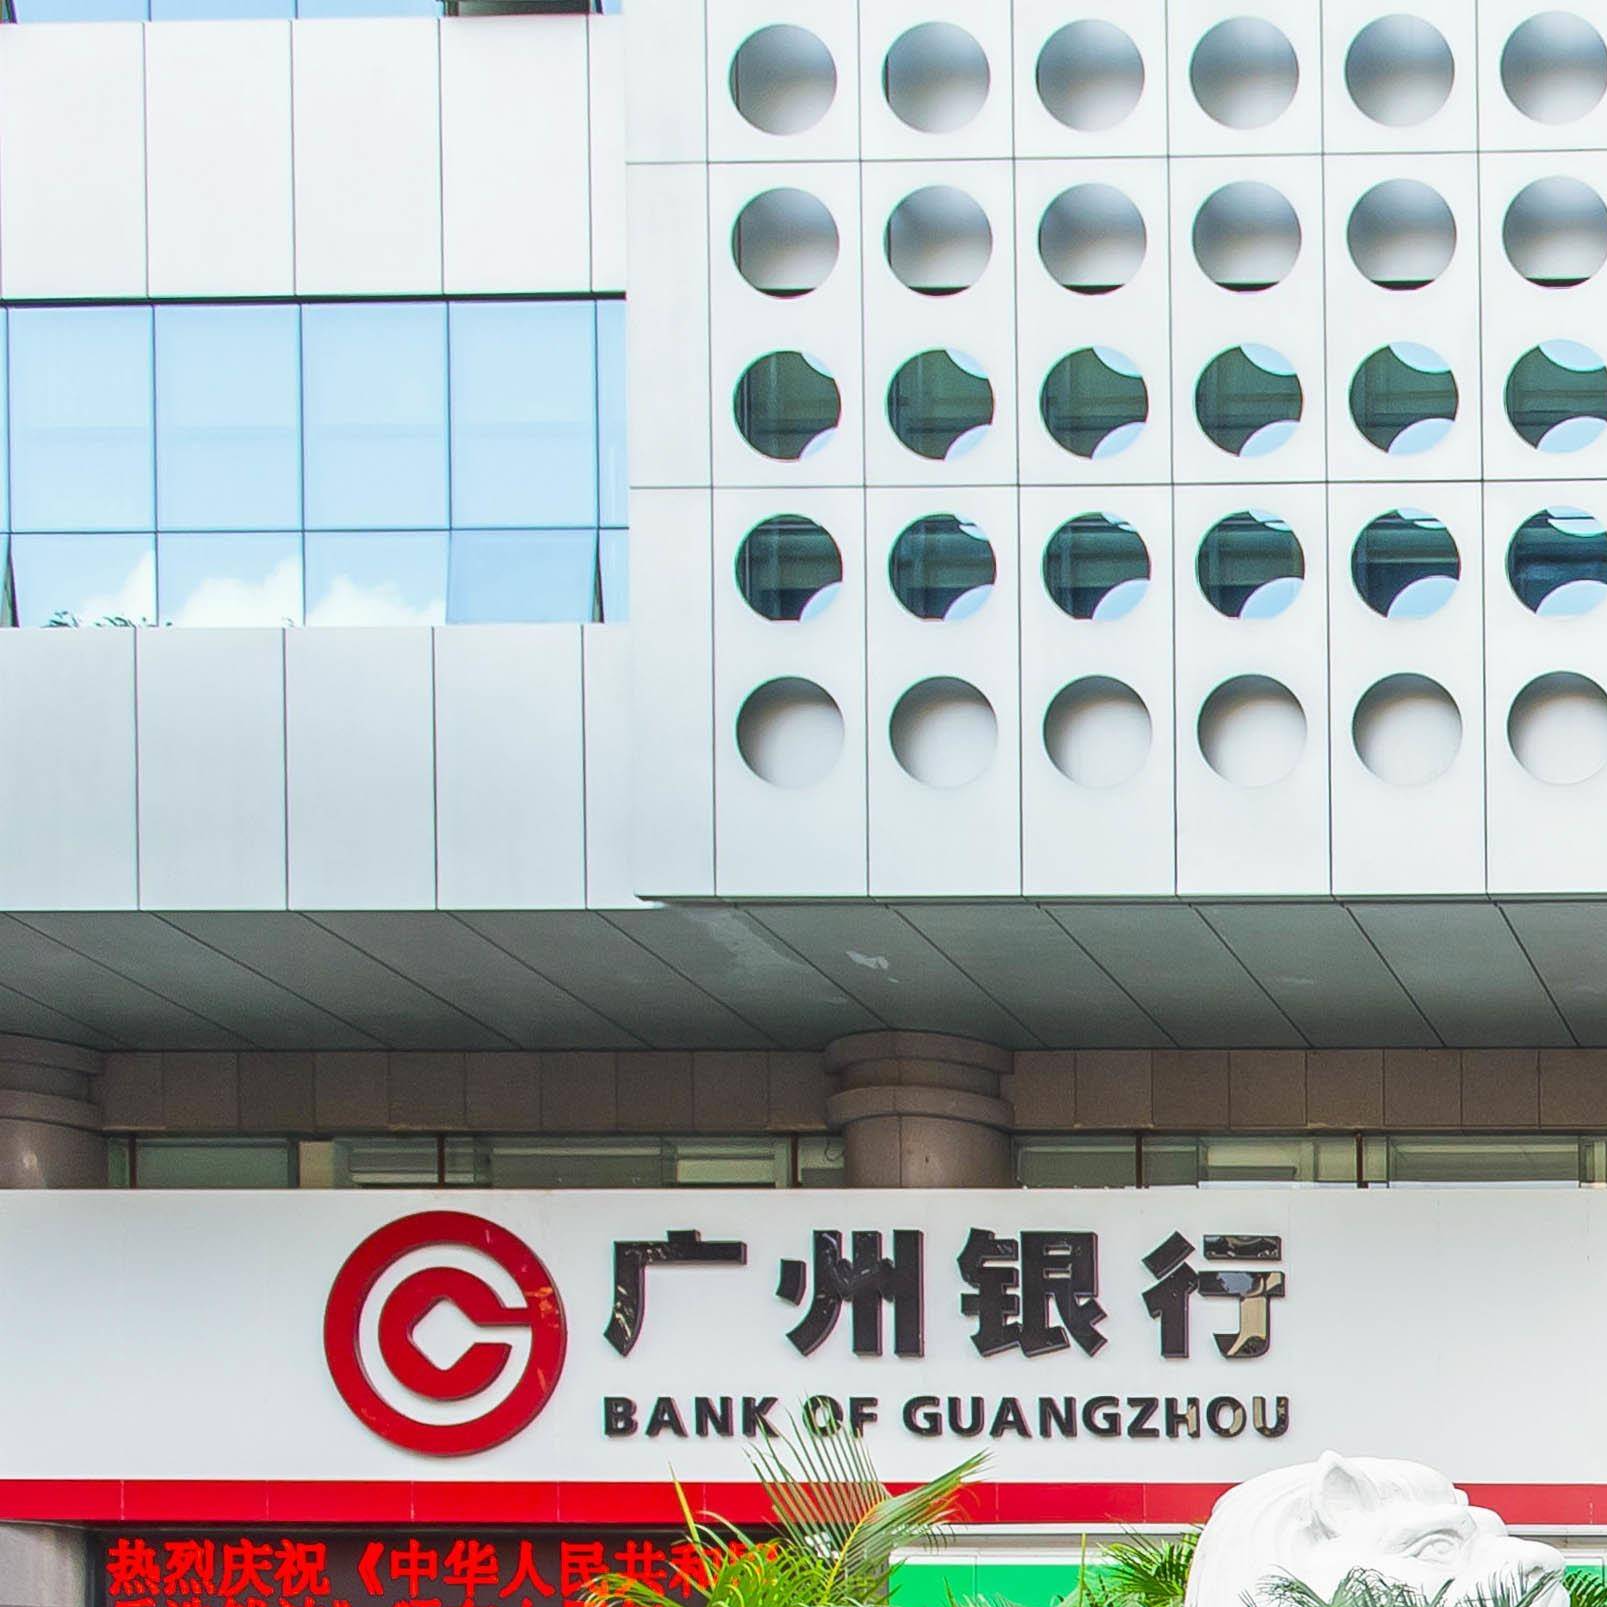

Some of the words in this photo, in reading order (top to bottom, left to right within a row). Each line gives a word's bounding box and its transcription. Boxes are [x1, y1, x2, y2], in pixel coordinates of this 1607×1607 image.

[603, 1228, 1286, 1358] 广州银行
[603, 1395, 779, 1439] BANK
[802, 1394, 878, 1438] OF
[902, 1395, 1289, 1440] GUANGZHOU
